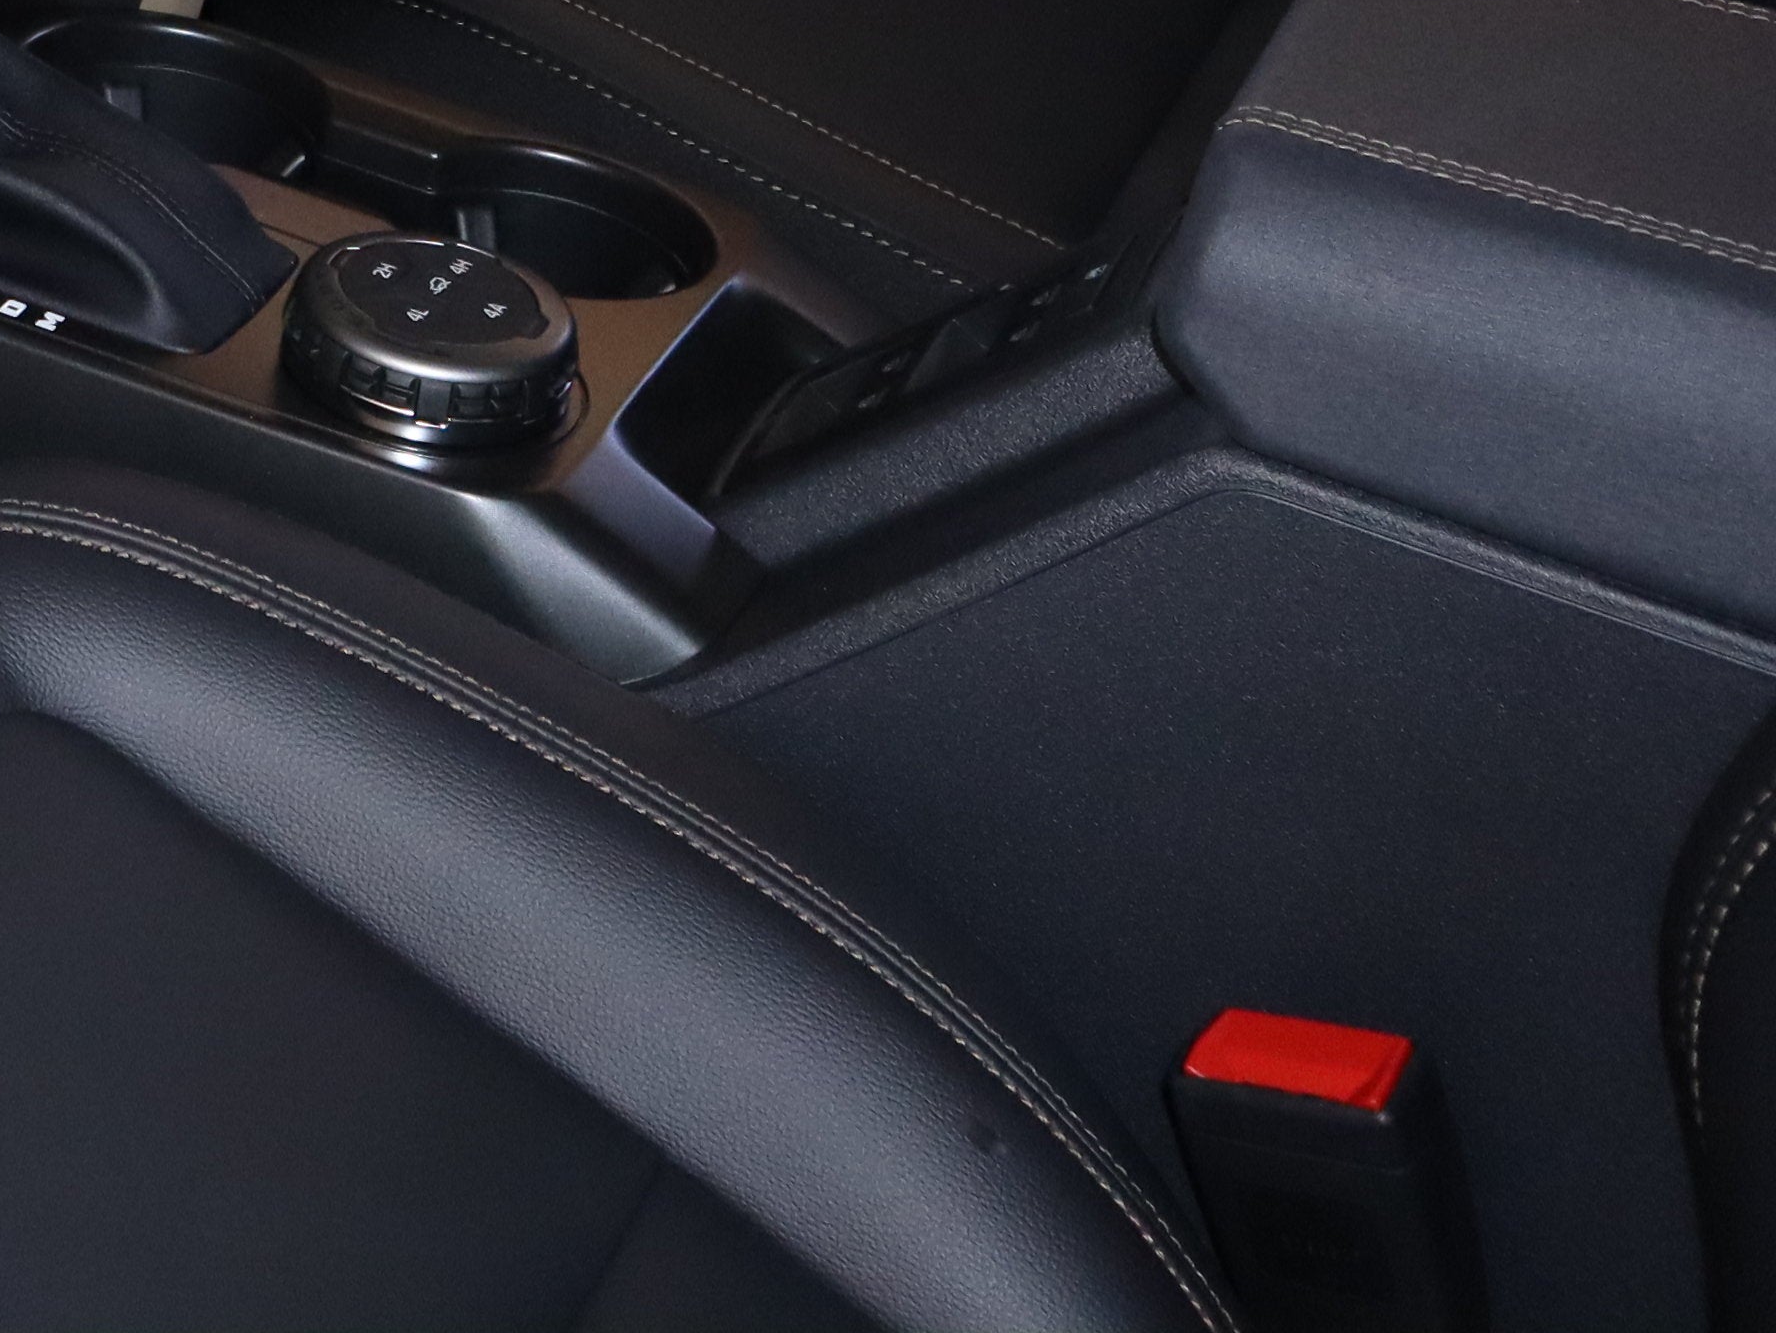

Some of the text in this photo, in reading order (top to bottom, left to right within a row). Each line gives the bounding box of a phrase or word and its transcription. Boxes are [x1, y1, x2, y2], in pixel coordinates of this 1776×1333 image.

[372, 261, 398, 280] 2H
[449, 258, 474, 276] 4H
[406, 307, 430, 322] 4L
[483, 302, 508, 319] 4A
[34, 310, 66, 332] M
